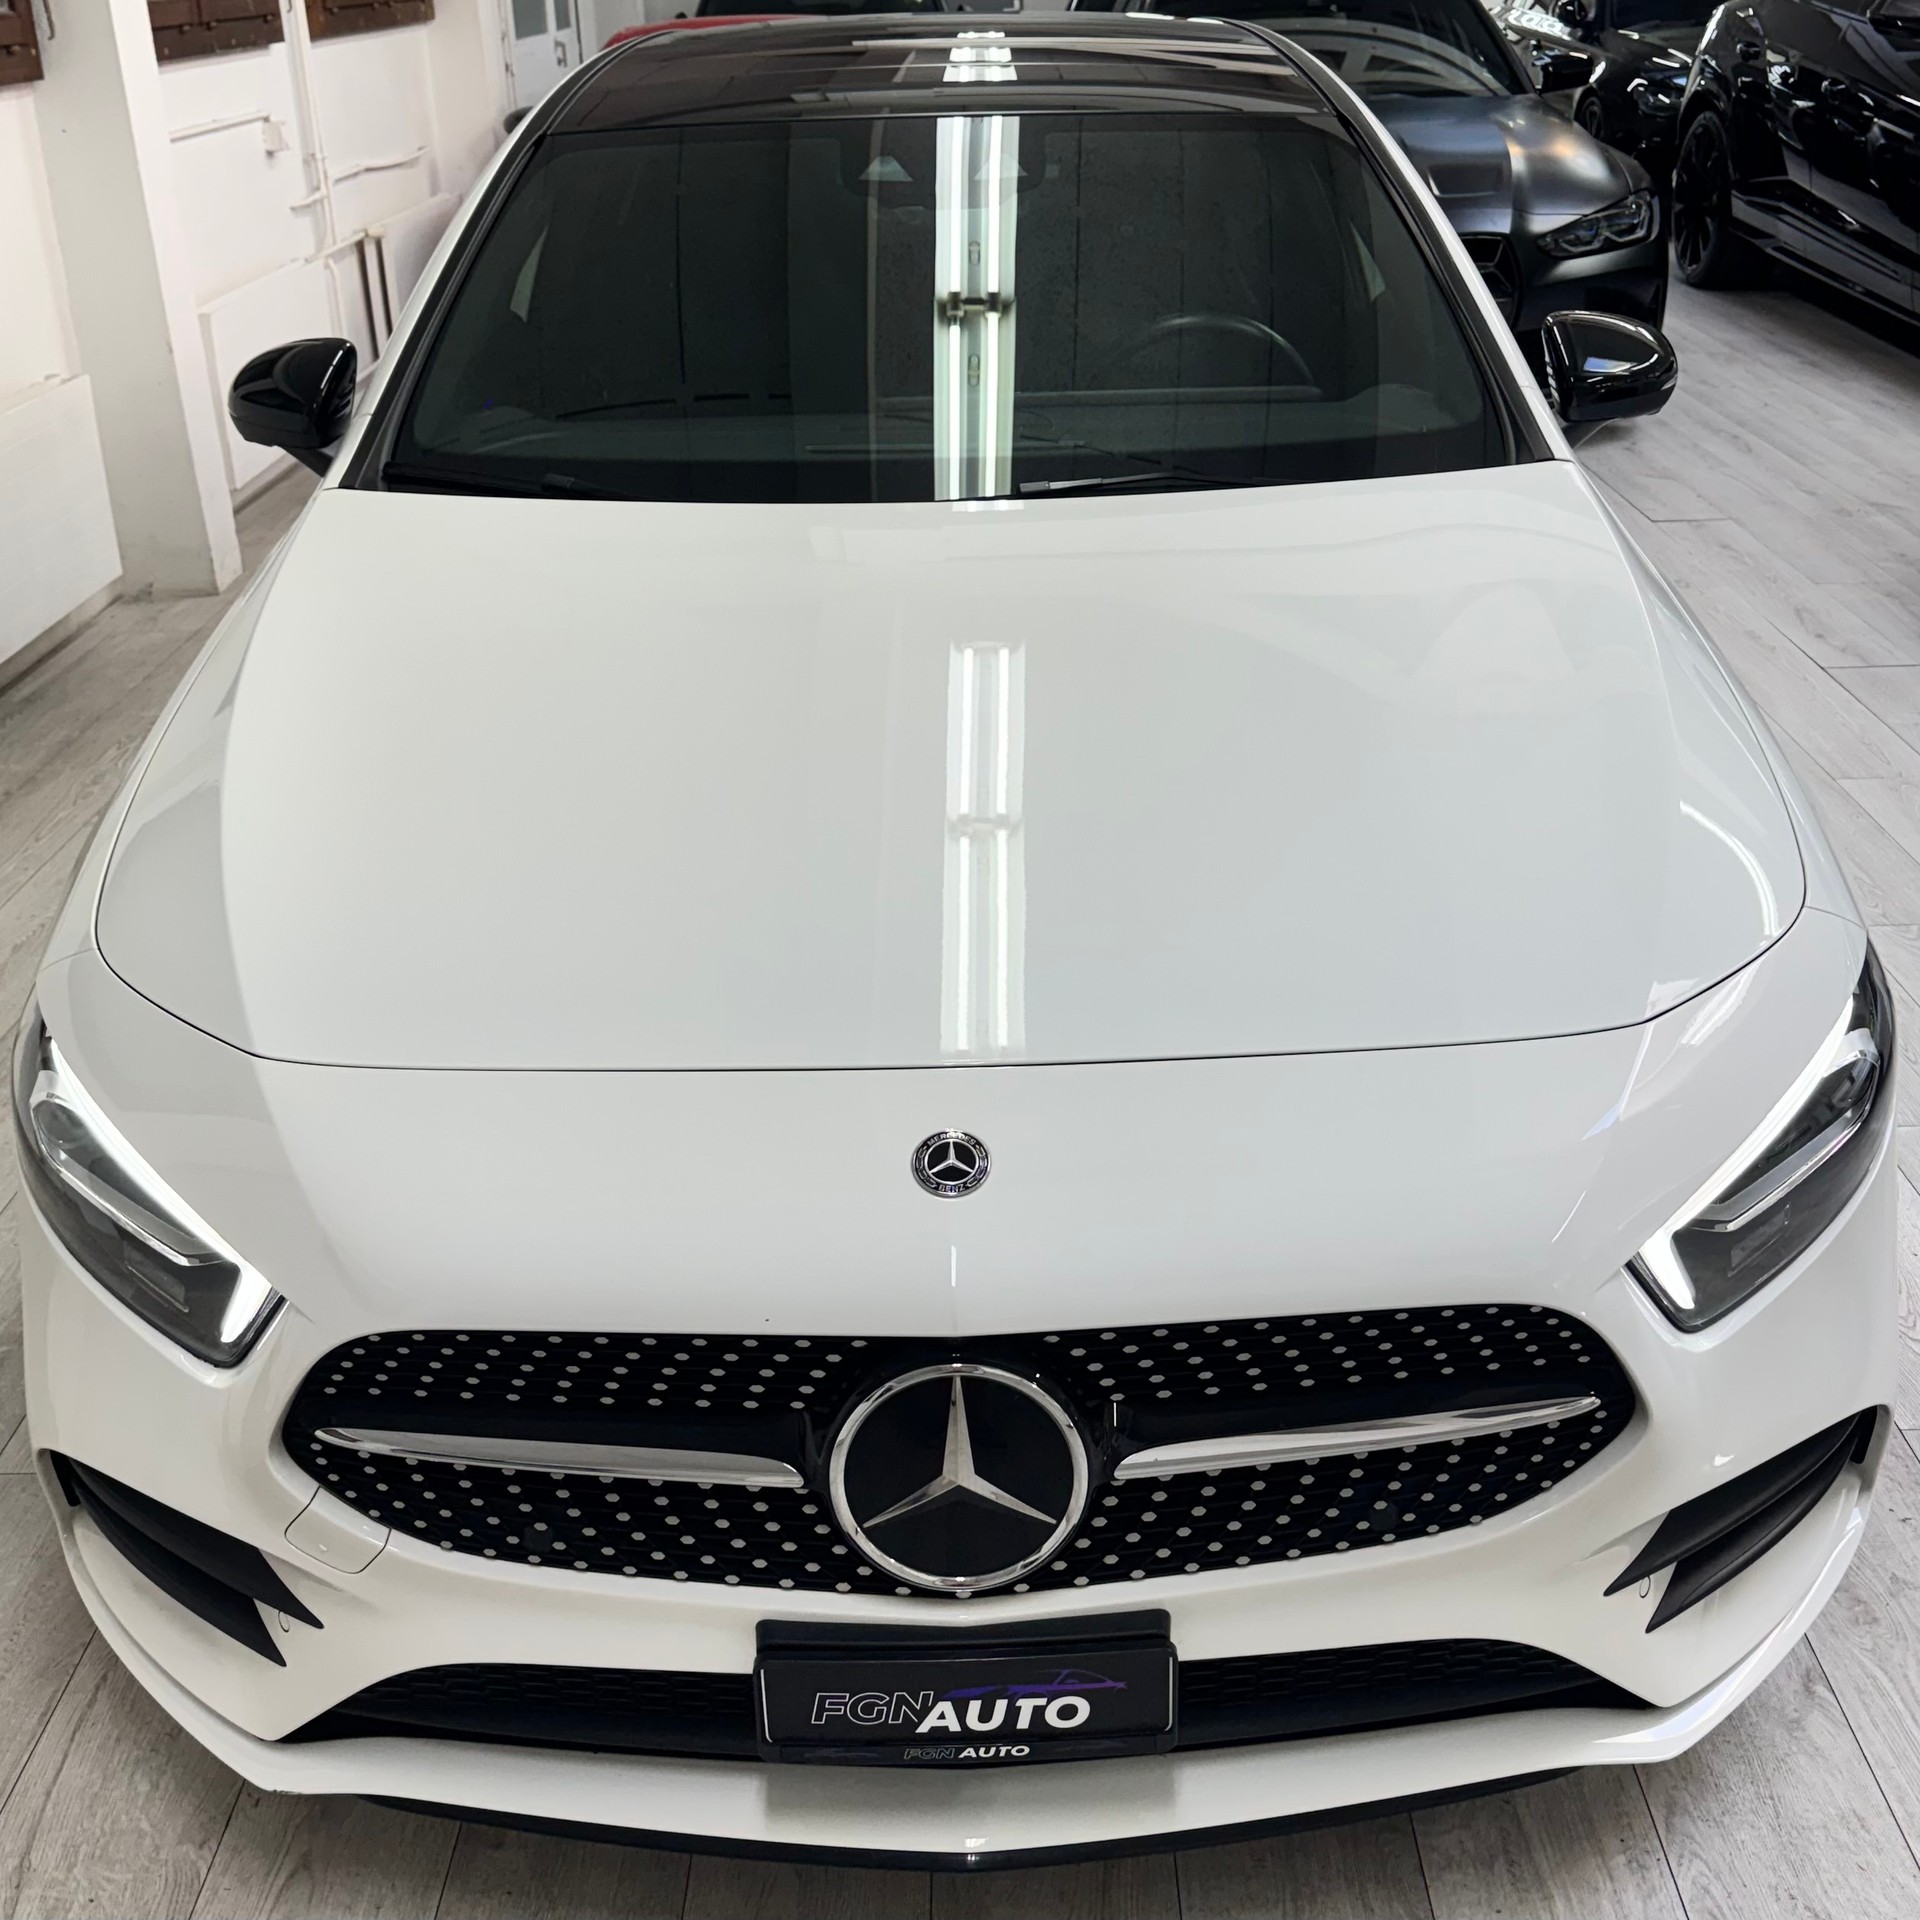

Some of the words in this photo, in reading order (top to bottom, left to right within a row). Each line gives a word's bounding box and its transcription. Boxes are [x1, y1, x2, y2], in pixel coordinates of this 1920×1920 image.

[938, 1184, 966, 1193] BENZ
[904, 1748, 955, 1760] FGN
[958, 1745, 1031, 1759] AUTO
